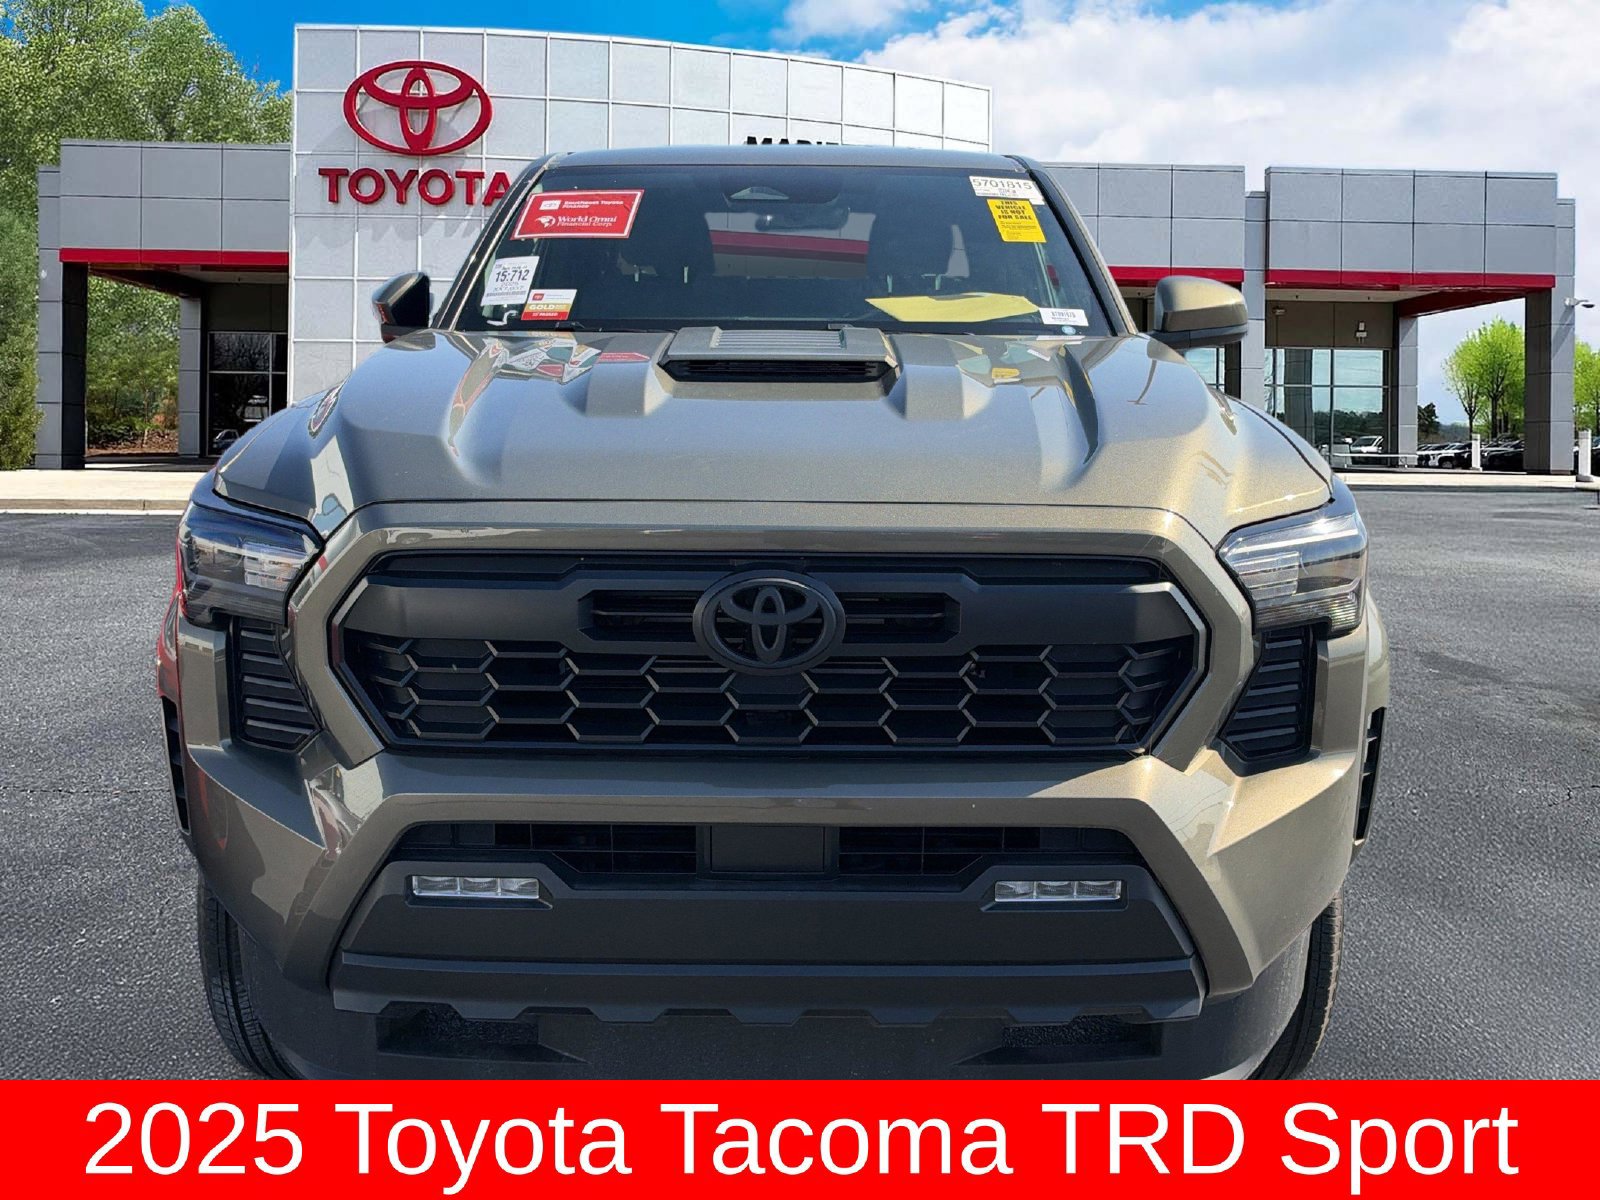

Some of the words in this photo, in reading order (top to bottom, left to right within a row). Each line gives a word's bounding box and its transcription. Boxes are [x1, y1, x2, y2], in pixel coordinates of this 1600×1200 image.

[318, 167, 512, 207] TOYOTA
[557, 215, 588, 223] World
[588, 215, 617, 223] Omni
